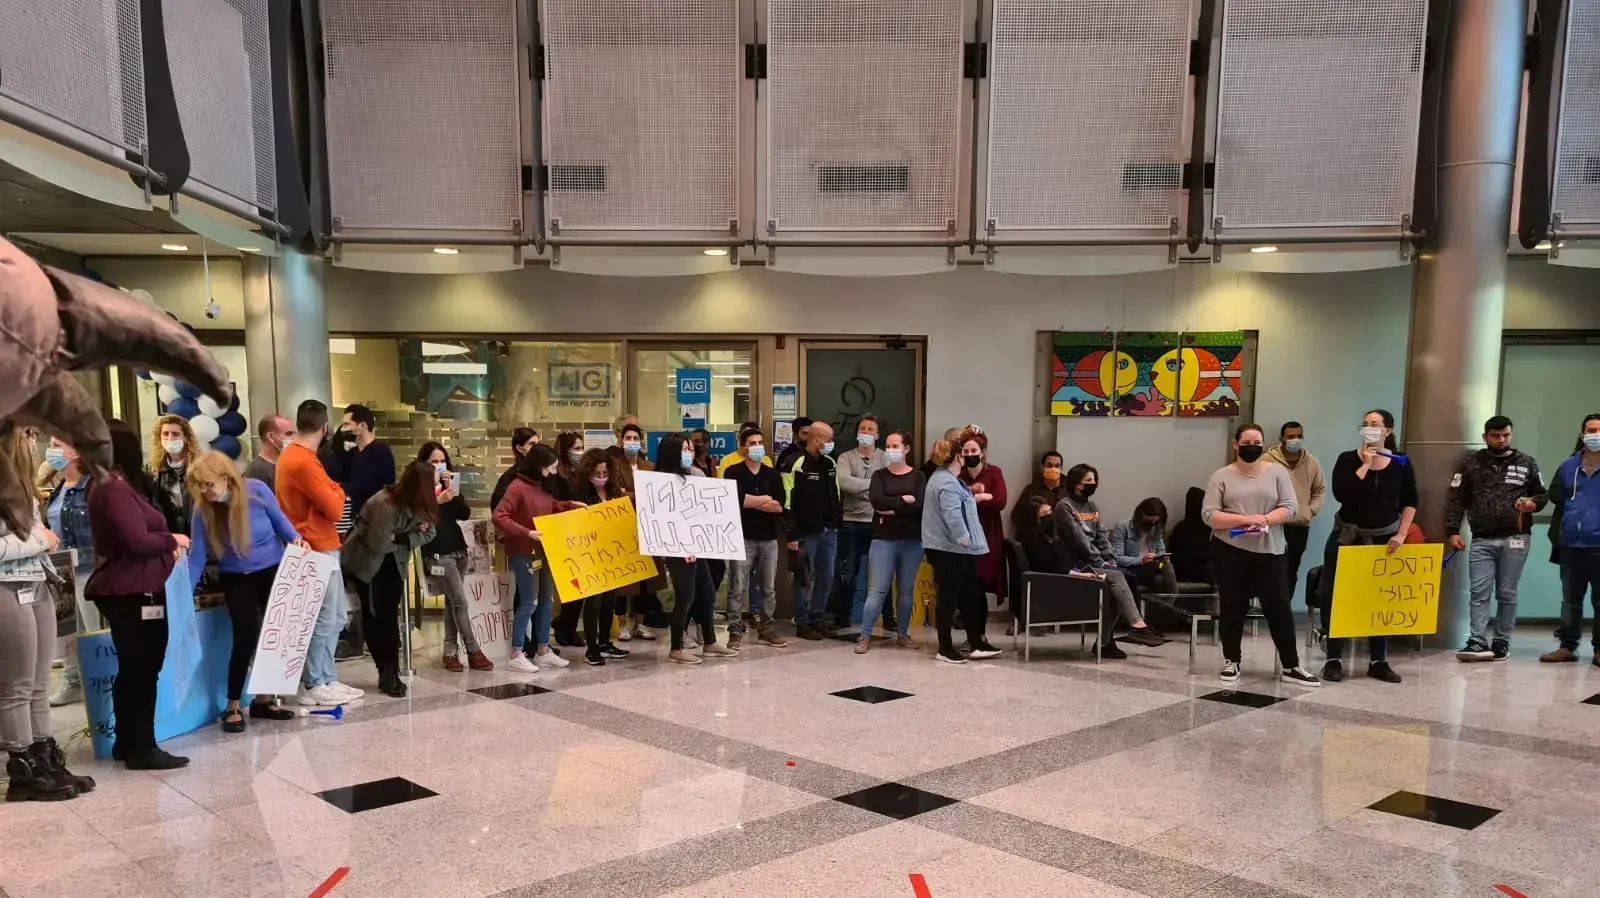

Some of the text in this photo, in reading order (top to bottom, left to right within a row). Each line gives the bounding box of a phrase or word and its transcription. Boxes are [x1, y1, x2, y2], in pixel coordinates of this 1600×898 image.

[555, 370, 602, 391] AIG
[683, 381, 704, 391] AIG
[646, 480, 729, 520] דברו
[588, 503, 629, 520] אחרי
[563, 535, 639, 576] נגמרה
[1372, 556, 1434, 577] הסכם
[1379, 582, 1435, 606] קיבוצי
[1371, 609, 1419, 630] עכשיו
